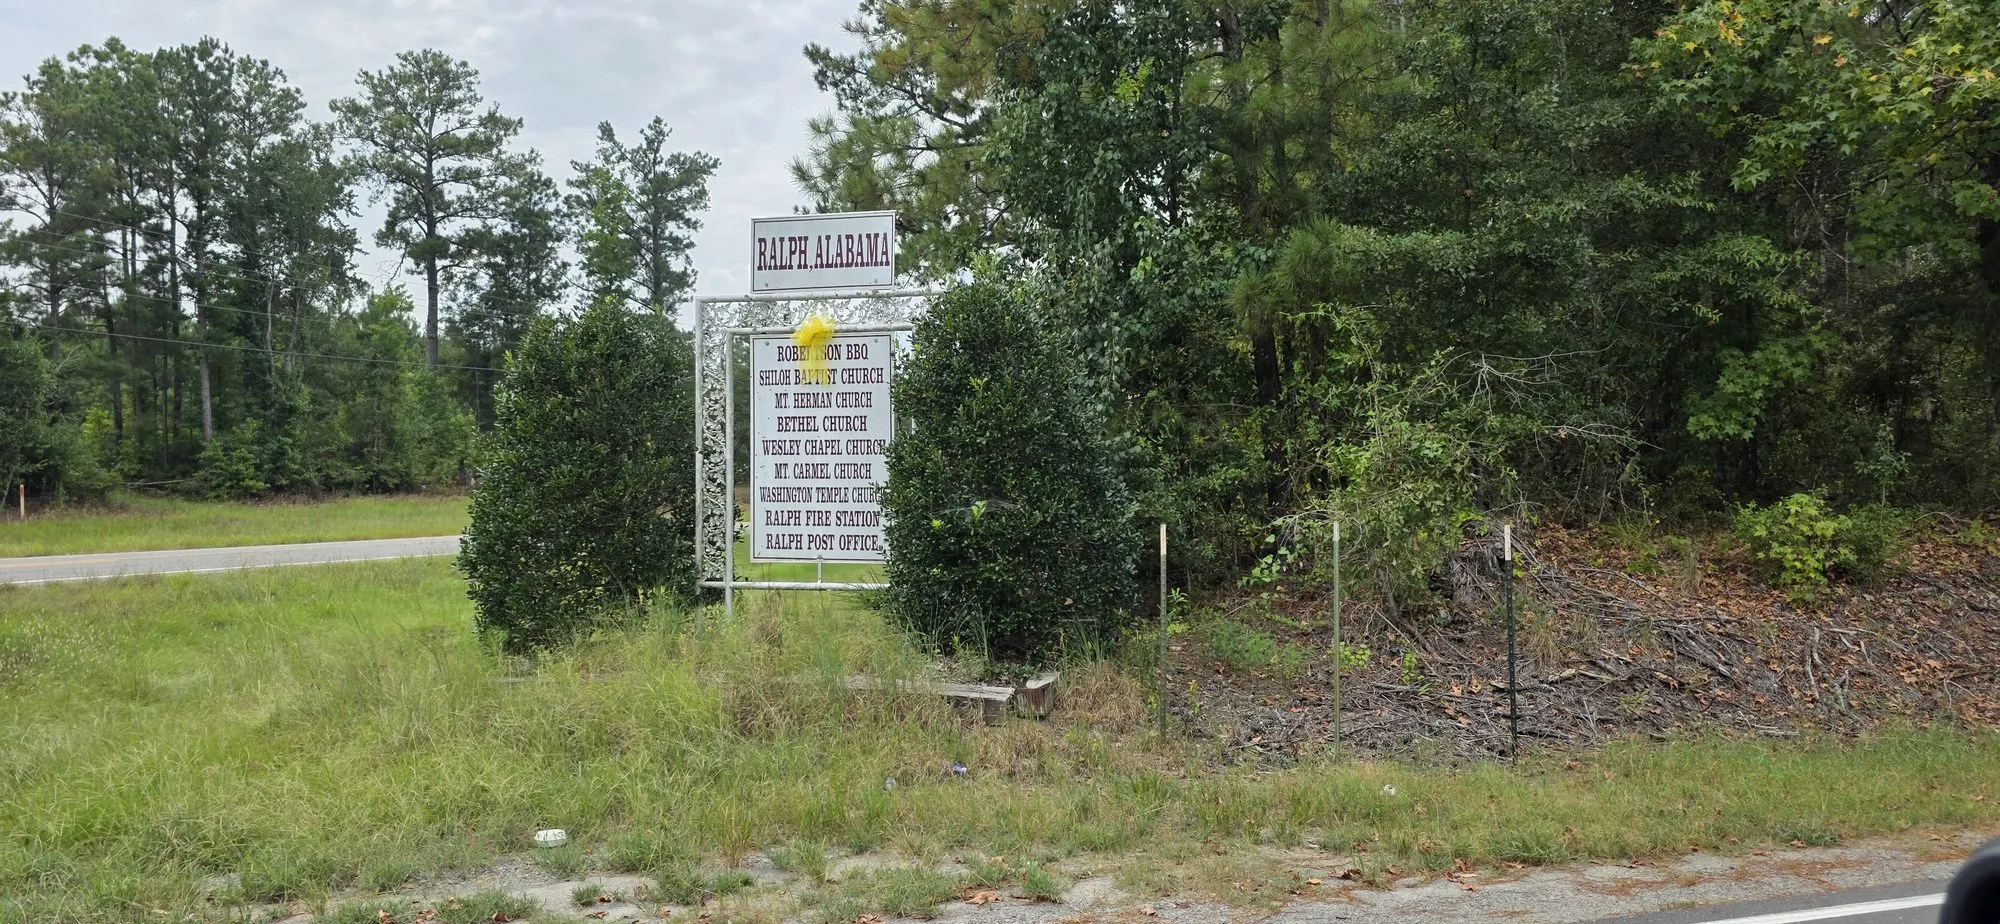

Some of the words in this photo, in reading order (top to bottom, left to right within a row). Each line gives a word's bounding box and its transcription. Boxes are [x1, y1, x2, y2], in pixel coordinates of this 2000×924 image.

[846, 343, 869, 360] BBQ
[759, 369, 791, 386] SHILOH
[841, 367, 884, 384] CHURCH
[774, 392, 790, 408] MT.
[793, 392, 832, 408] HERMAN
[835, 392, 872, 408] CHURCH
[777, 416, 819, 432] BETHEL
[823, 415, 867, 432] CHURCH
[763, 439, 801, 455] WESLEY
[804, 439, 842, 455] CHAPEL
[774, 463, 790, 479] MT.
[793, 463, 831, 479] CARMEL
[834, 463, 872, 479] CHURCH
[760, 487, 813, 503] WASHINGTON
[816, 487, 849, 503] TEMPLE
[852, 487, 885, 503] CHURC
[765, 510, 801, 526] RALPH
[805, 510, 832, 526] FIRE
[835, 511, 880, 527] STATION
[766, 534, 803, 550] RALPH
[807, 534, 835, 550] POST
[839, 535, 879, 551] OFFICE
